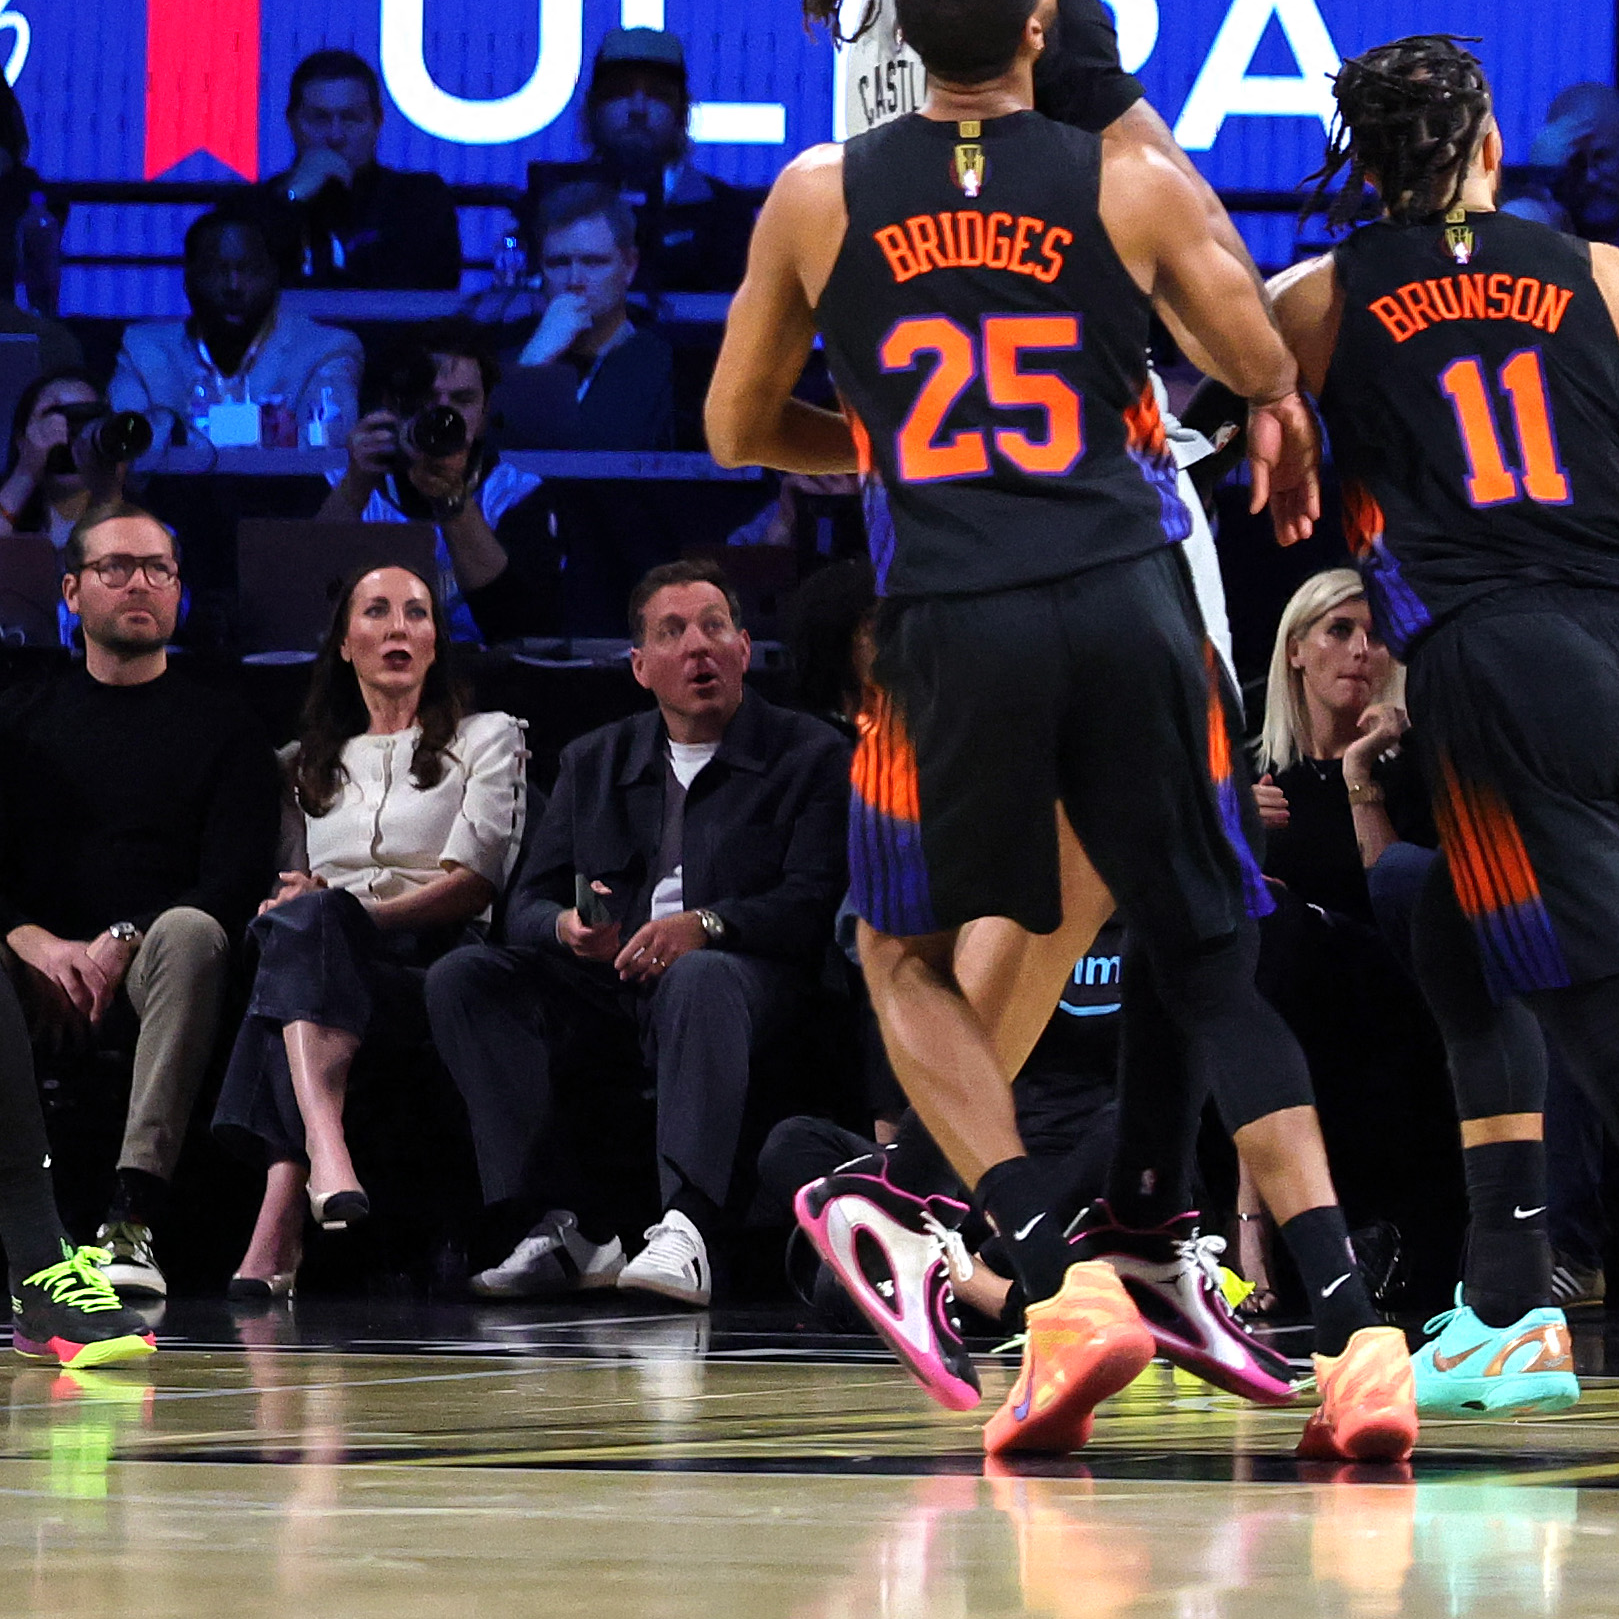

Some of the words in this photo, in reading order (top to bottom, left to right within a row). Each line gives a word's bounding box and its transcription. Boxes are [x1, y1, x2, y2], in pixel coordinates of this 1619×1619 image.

[859, 58, 926, 126] CASTL
[873, 210, 1074, 284] BRIDGES
[1367, 273, 1574, 343] BRUNSON
[878, 312, 1087, 484] 25
[1437, 344, 1574, 509] 11
